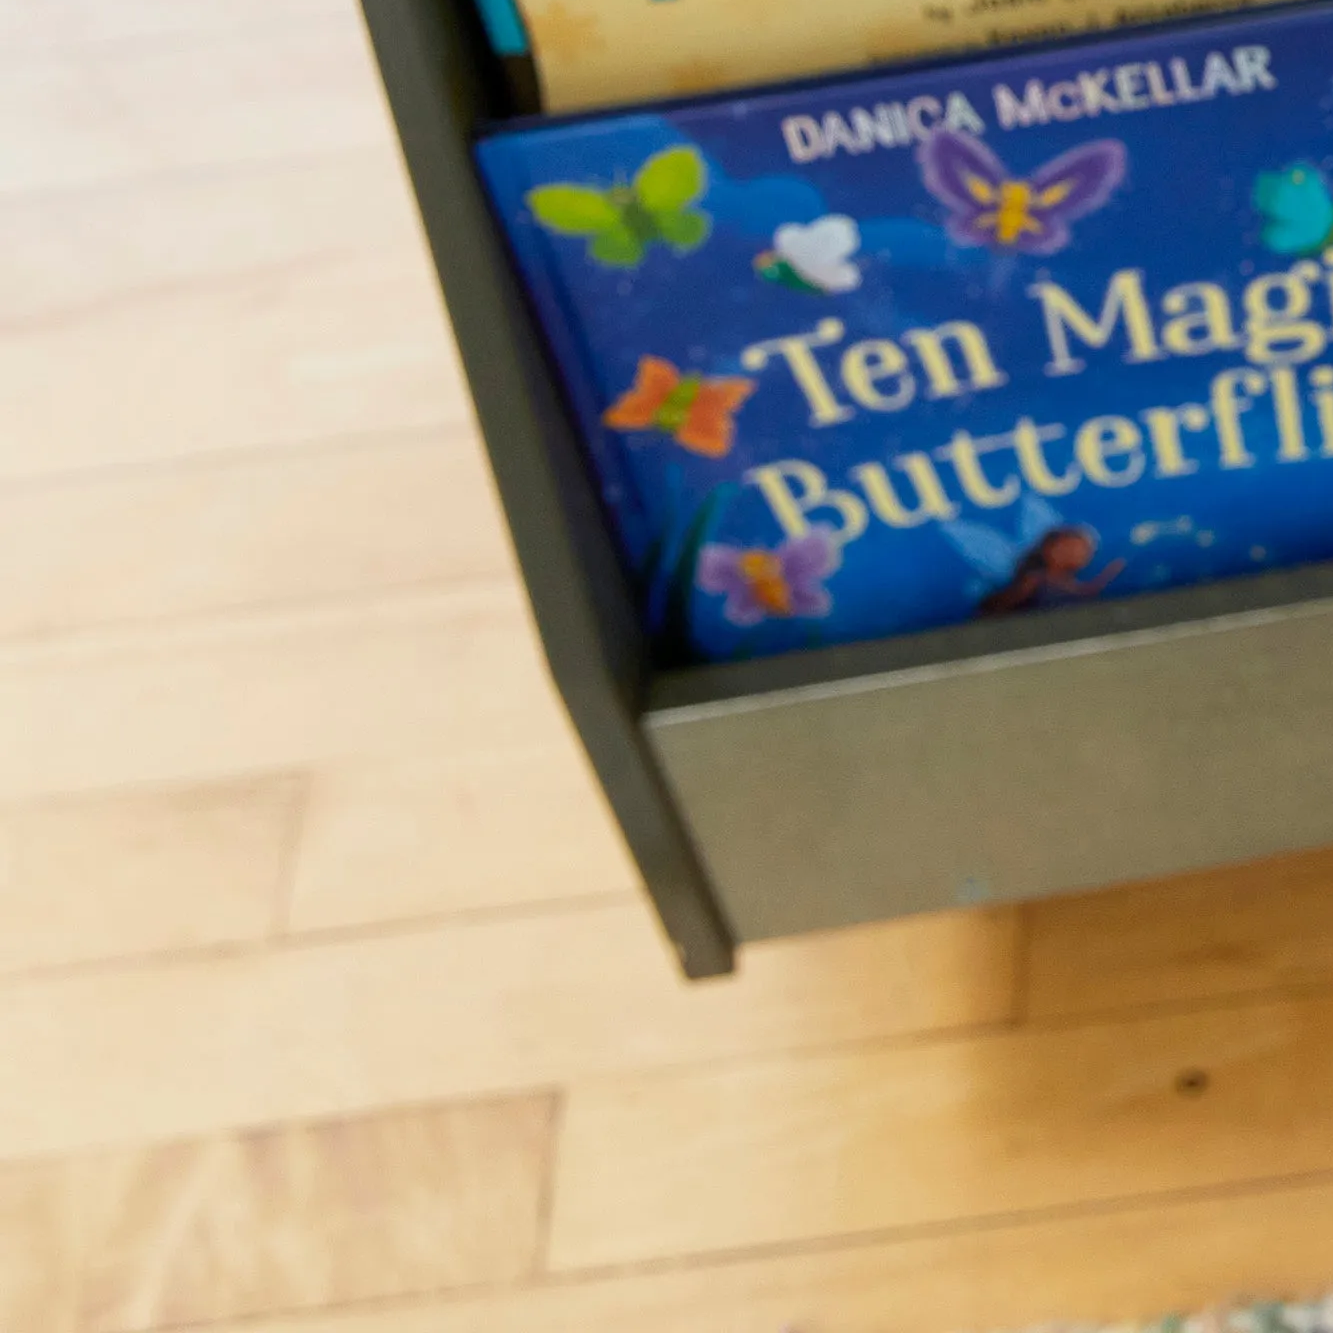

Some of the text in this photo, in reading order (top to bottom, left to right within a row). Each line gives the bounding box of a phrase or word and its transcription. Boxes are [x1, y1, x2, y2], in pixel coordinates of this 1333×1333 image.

[780, 44, 1279, 165] DANICA McKELLAR
[739, 316, 1010, 430] Ten
